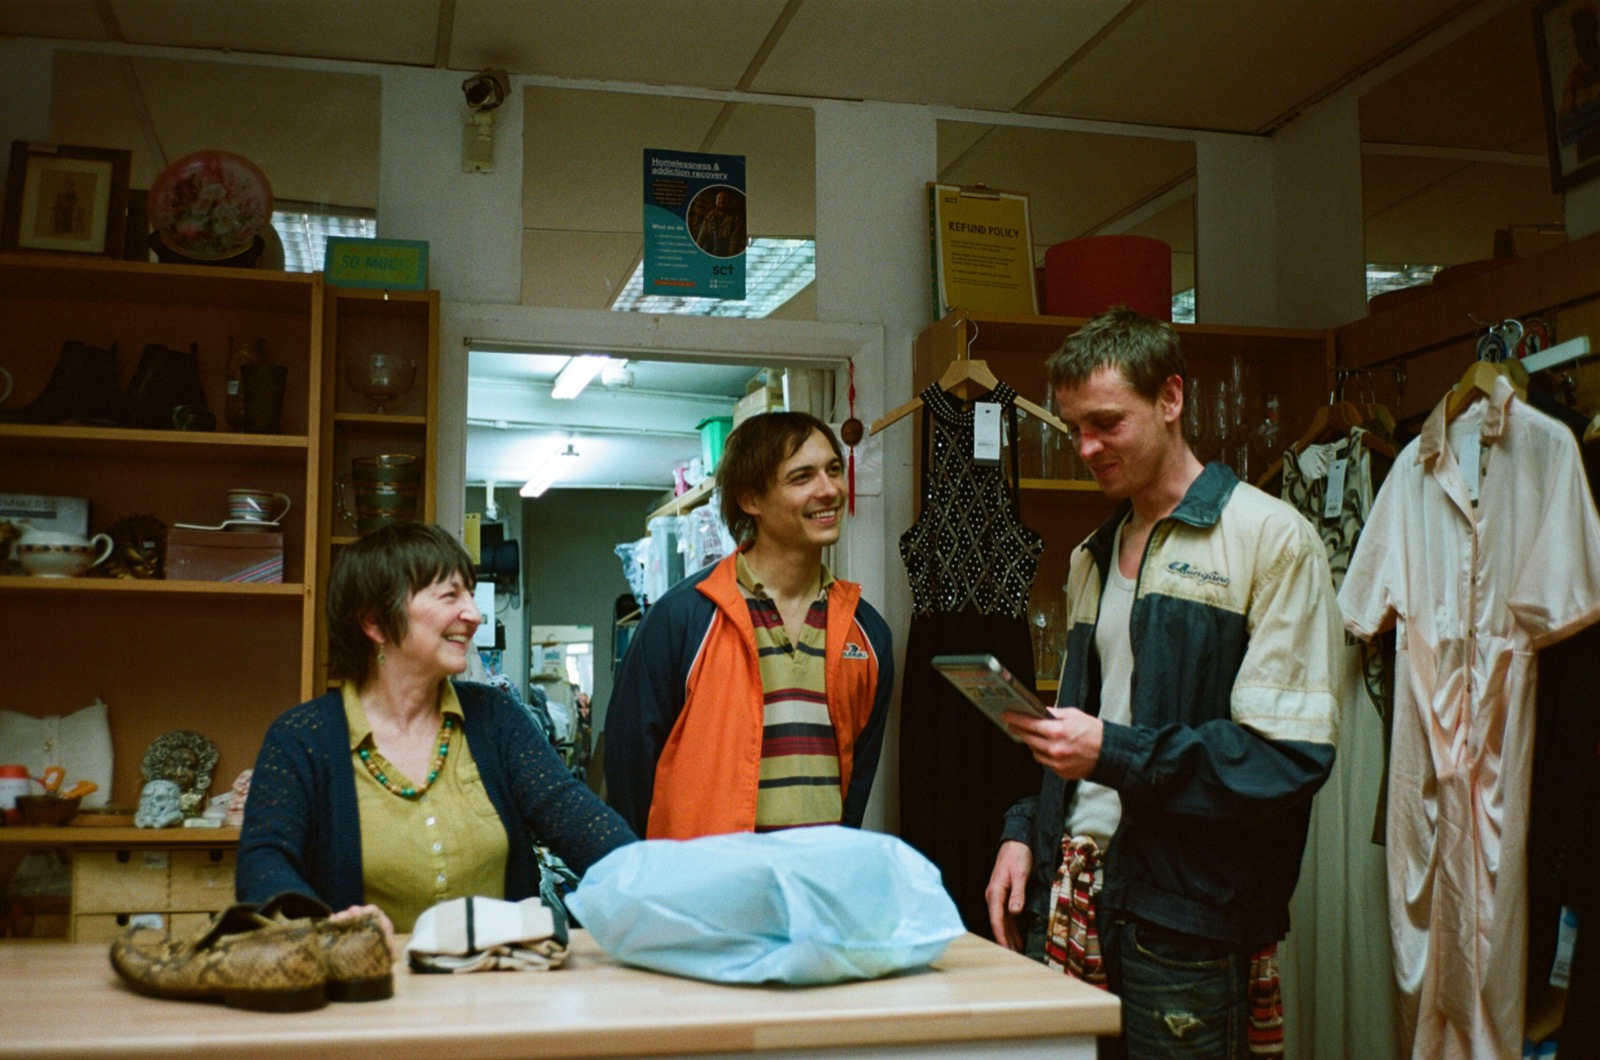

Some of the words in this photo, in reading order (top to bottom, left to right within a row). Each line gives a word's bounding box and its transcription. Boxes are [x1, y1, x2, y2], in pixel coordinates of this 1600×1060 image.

[651, 158, 711, 170] Homelessness
[713, 162, 720, 170] &
[651, 167, 691, 177] addiction
[692, 171, 728, 180] recovery
[948, 221, 986, 235] REFUND
[988, 226, 1019, 239] POLICY
[341, 255, 360, 268] SO
